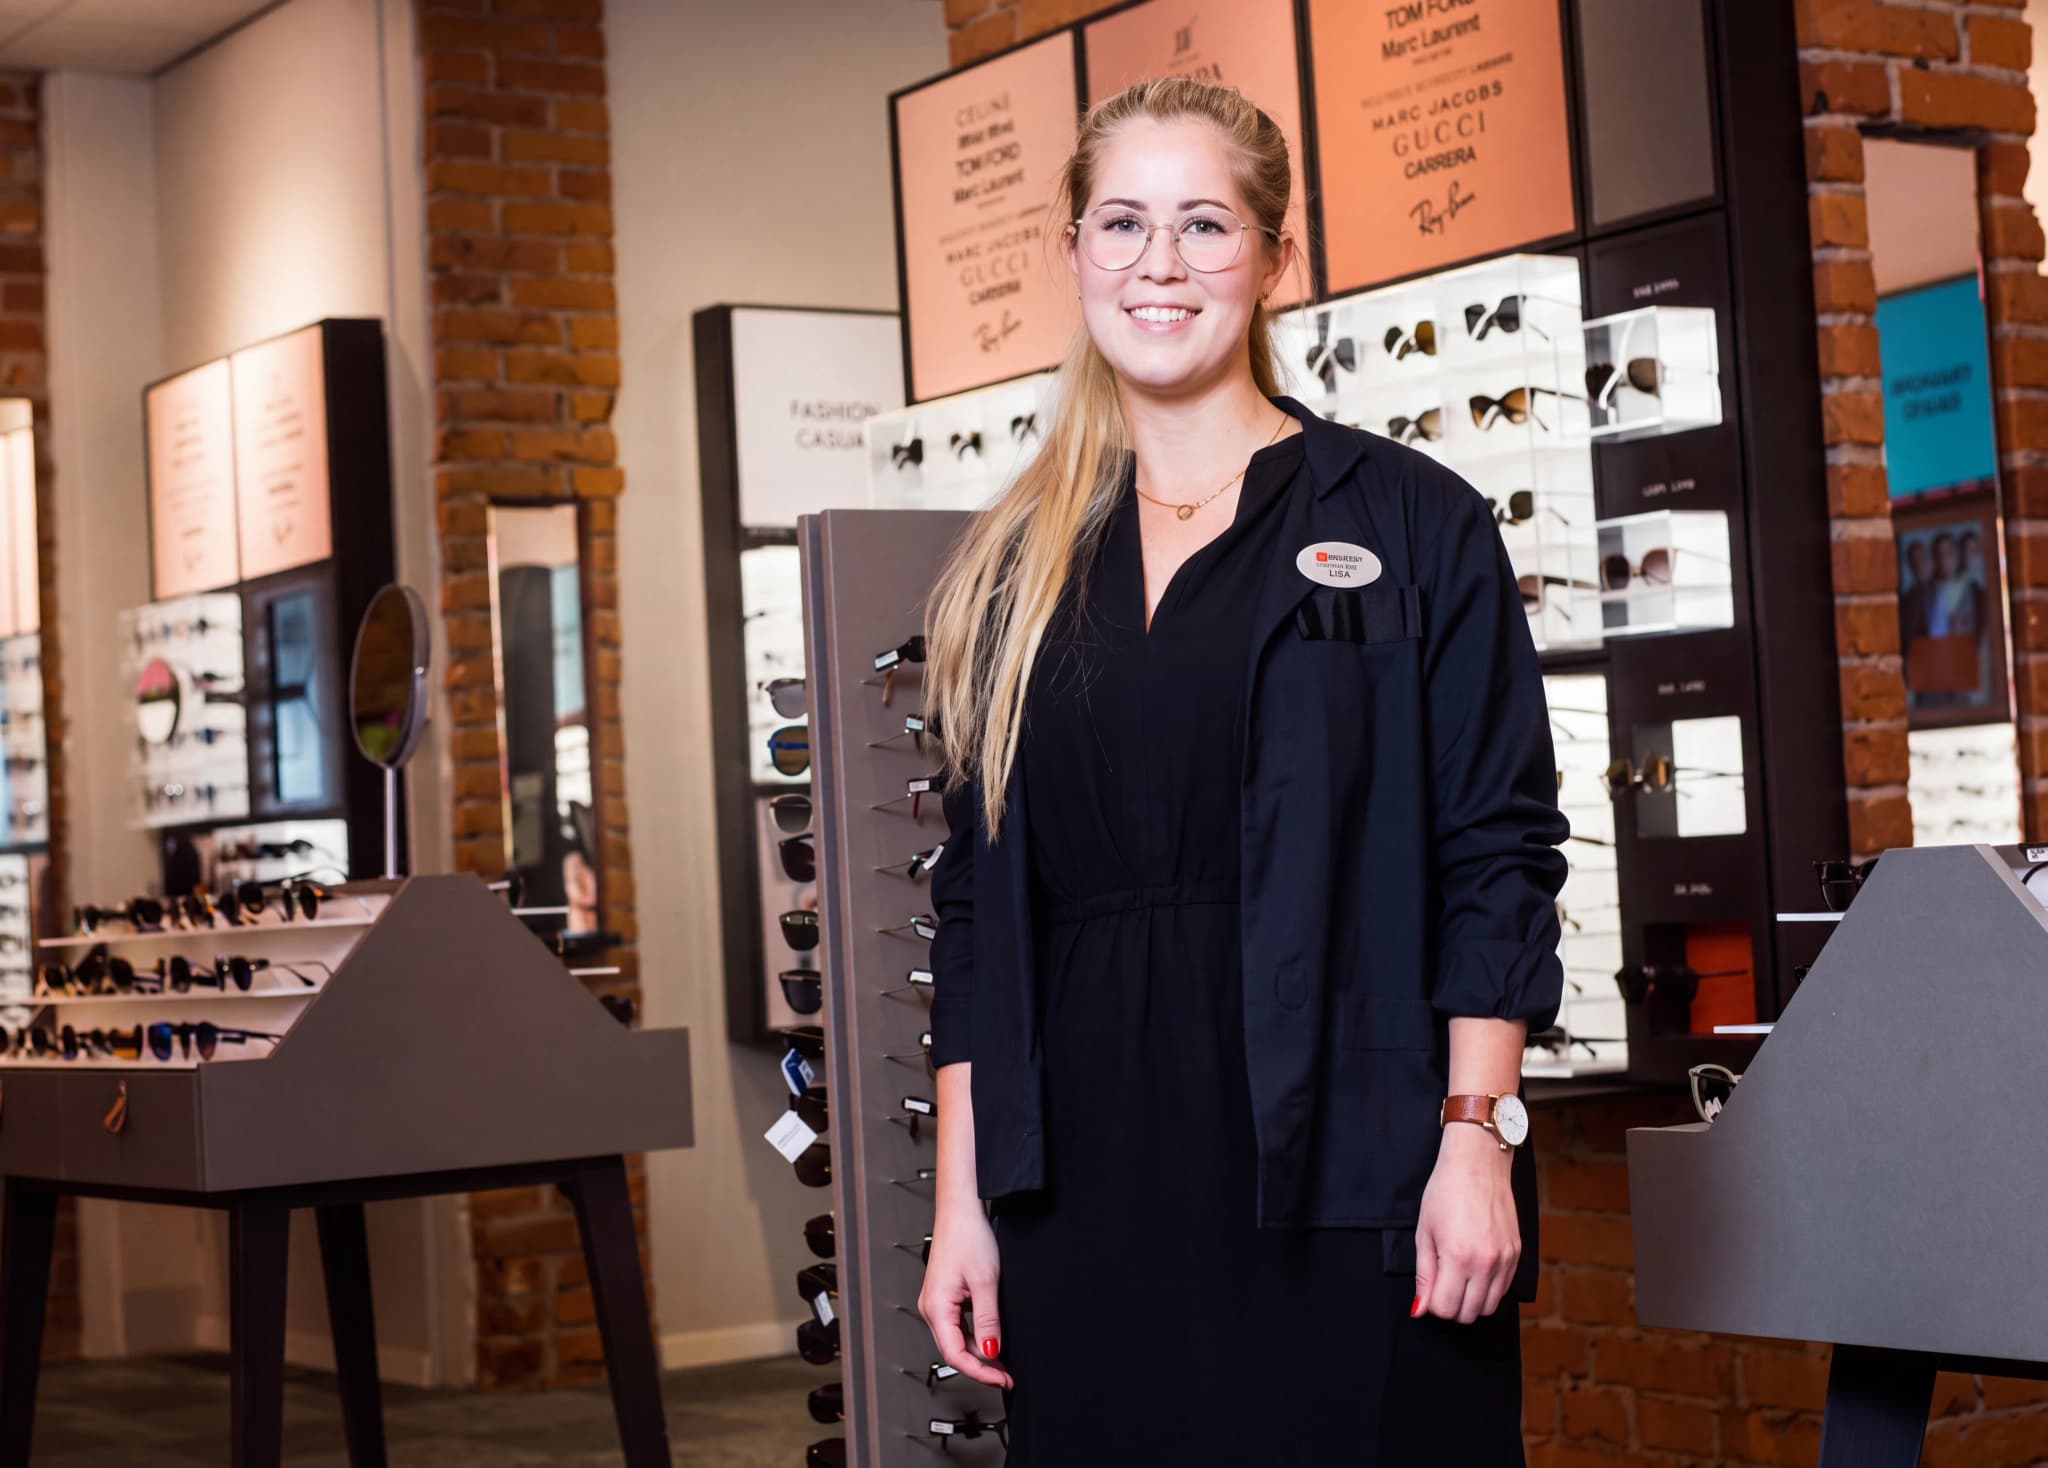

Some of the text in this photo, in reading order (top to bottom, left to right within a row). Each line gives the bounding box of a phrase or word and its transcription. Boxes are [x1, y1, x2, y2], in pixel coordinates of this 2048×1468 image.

[1385, 0, 1423, 30] TOM
[1382, 37, 1418, 58] Marc
[1422, 13, 1479, 47] Laurent
[1371, 104, 1420, 132] MARC
[1428, 79, 1504, 117] JACOBS
[1392, 109, 1486, 157] GUCCI
[1403, 145, 1478, 180] CARRERA
[960, 250, 1029, 288] GUCCI
[1329, 570, 1351, 578] LISA
